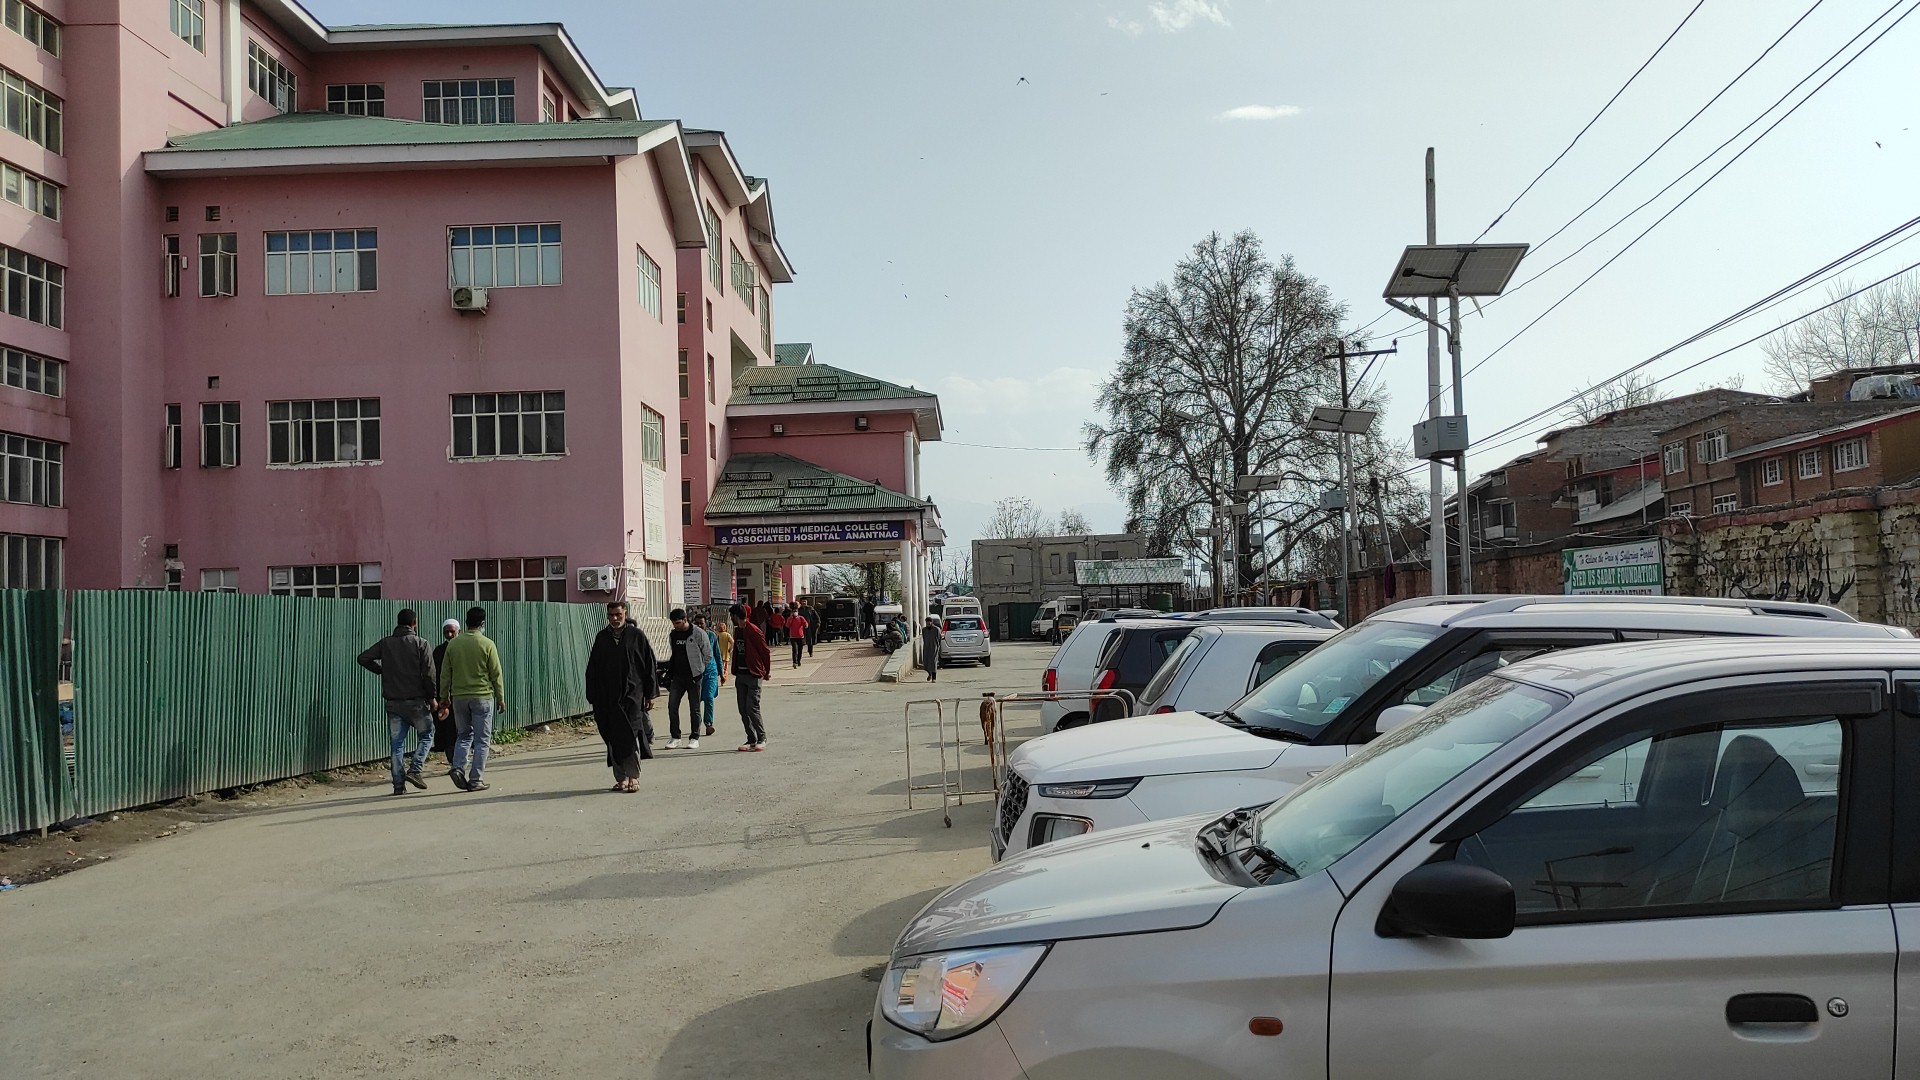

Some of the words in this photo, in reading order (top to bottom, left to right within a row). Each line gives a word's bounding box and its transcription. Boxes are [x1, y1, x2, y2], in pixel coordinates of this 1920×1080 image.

[731, 526, 797, 535] GOVERNMENT
[800, 525, 842, 533] MEDICAL
[845, 523, 888, 531] COLLEGE
[731, 534, 791, 543] ASSOCIATED
[793, 532, 840, 541] HOSPITAL
[846, 530, 899, 540] ANANTNAG
[1588, 570, 1596, 585] US
[1618, 564, 1658, 584] FOUNDATION
